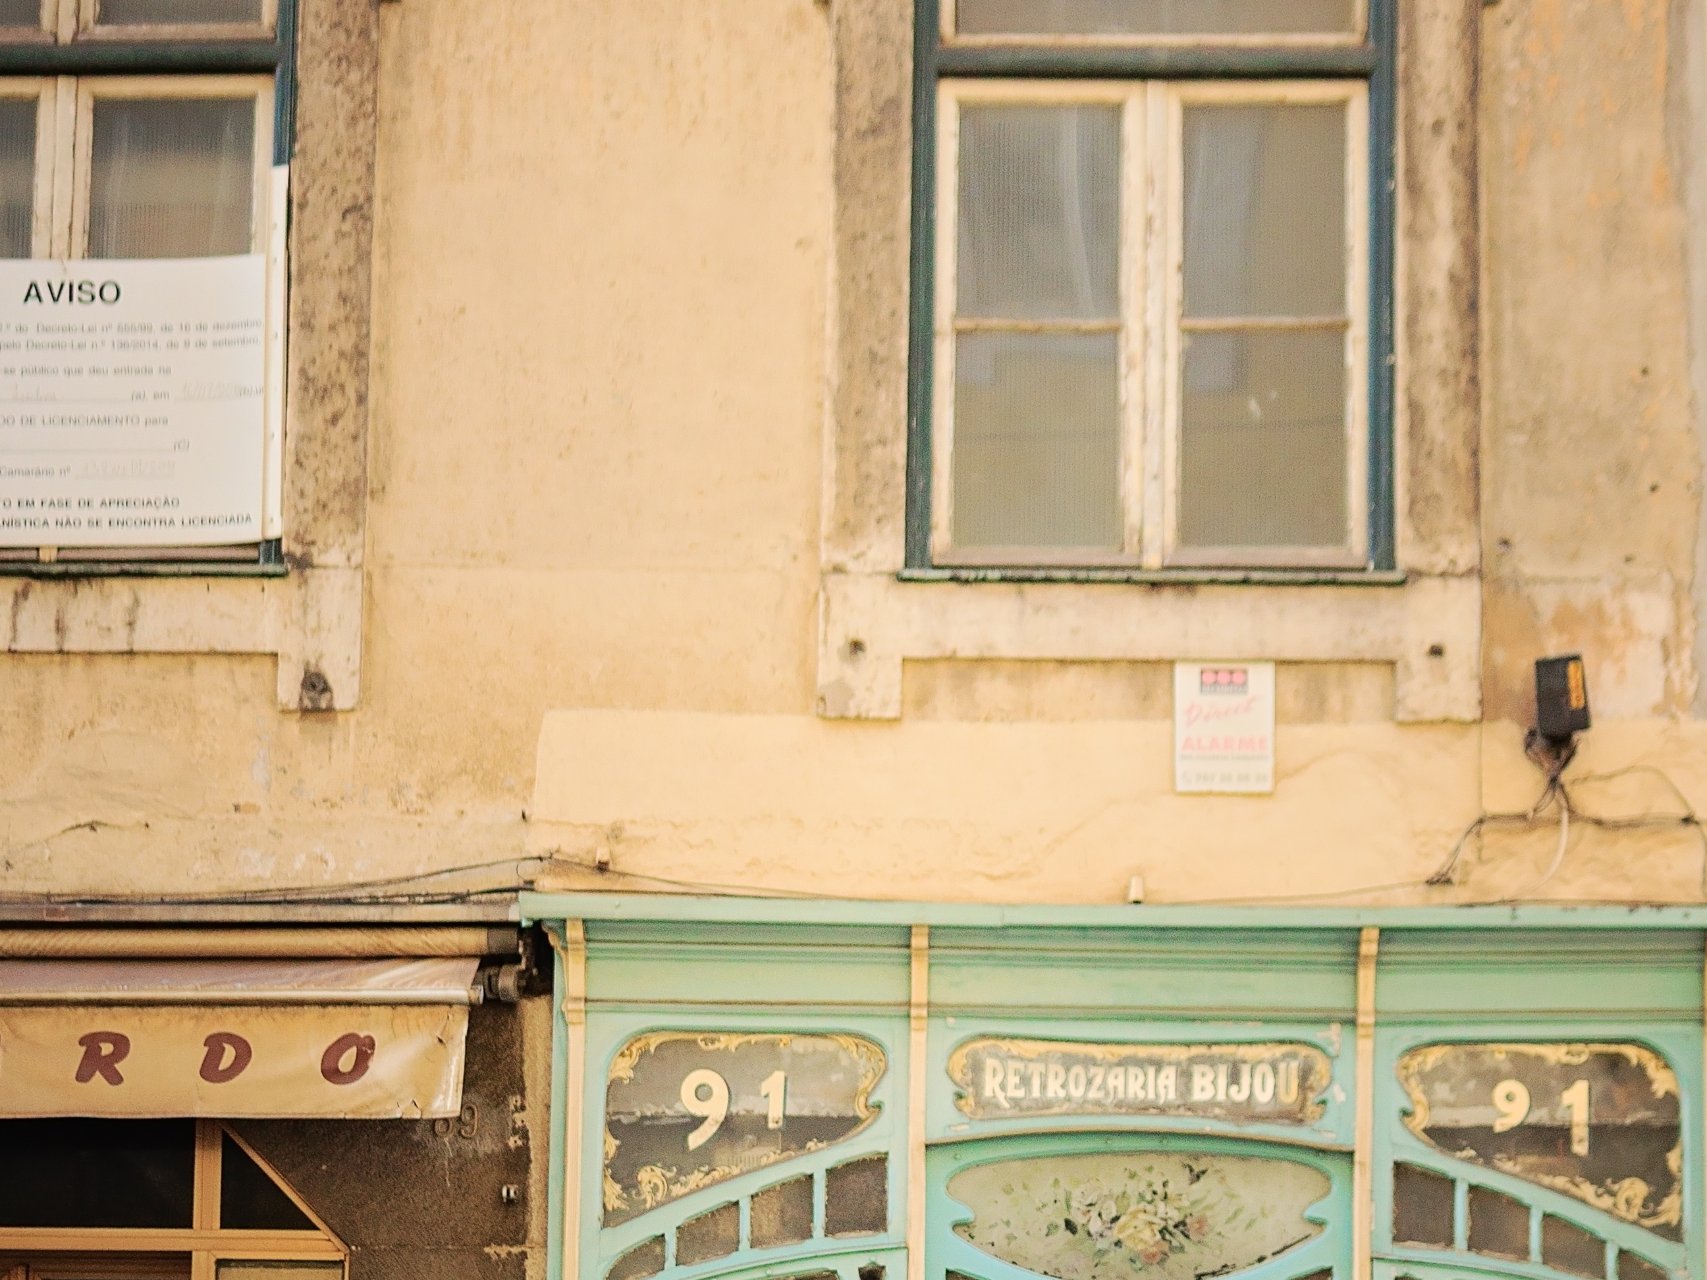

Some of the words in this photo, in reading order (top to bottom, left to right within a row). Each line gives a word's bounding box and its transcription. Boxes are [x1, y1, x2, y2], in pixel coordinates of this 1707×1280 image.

[23, 280, 122, 304] AVISO
[42, 414, 141, 426] LICENCIAMENTO
[17, 498, 36, 510] EM
[78, 498, 94, 510] DE
[108, 516, 176, 529] ENCONTRA
[181, 513, 253, 529] LICENCIADA
[983, 1057, 1178, 1109] RETROZARIA
[1191, 1059, 1300, 1104] BIJOU
[680, 1068, 787, 1151] 91
[1492, 1079, 1590, 1157] 91
